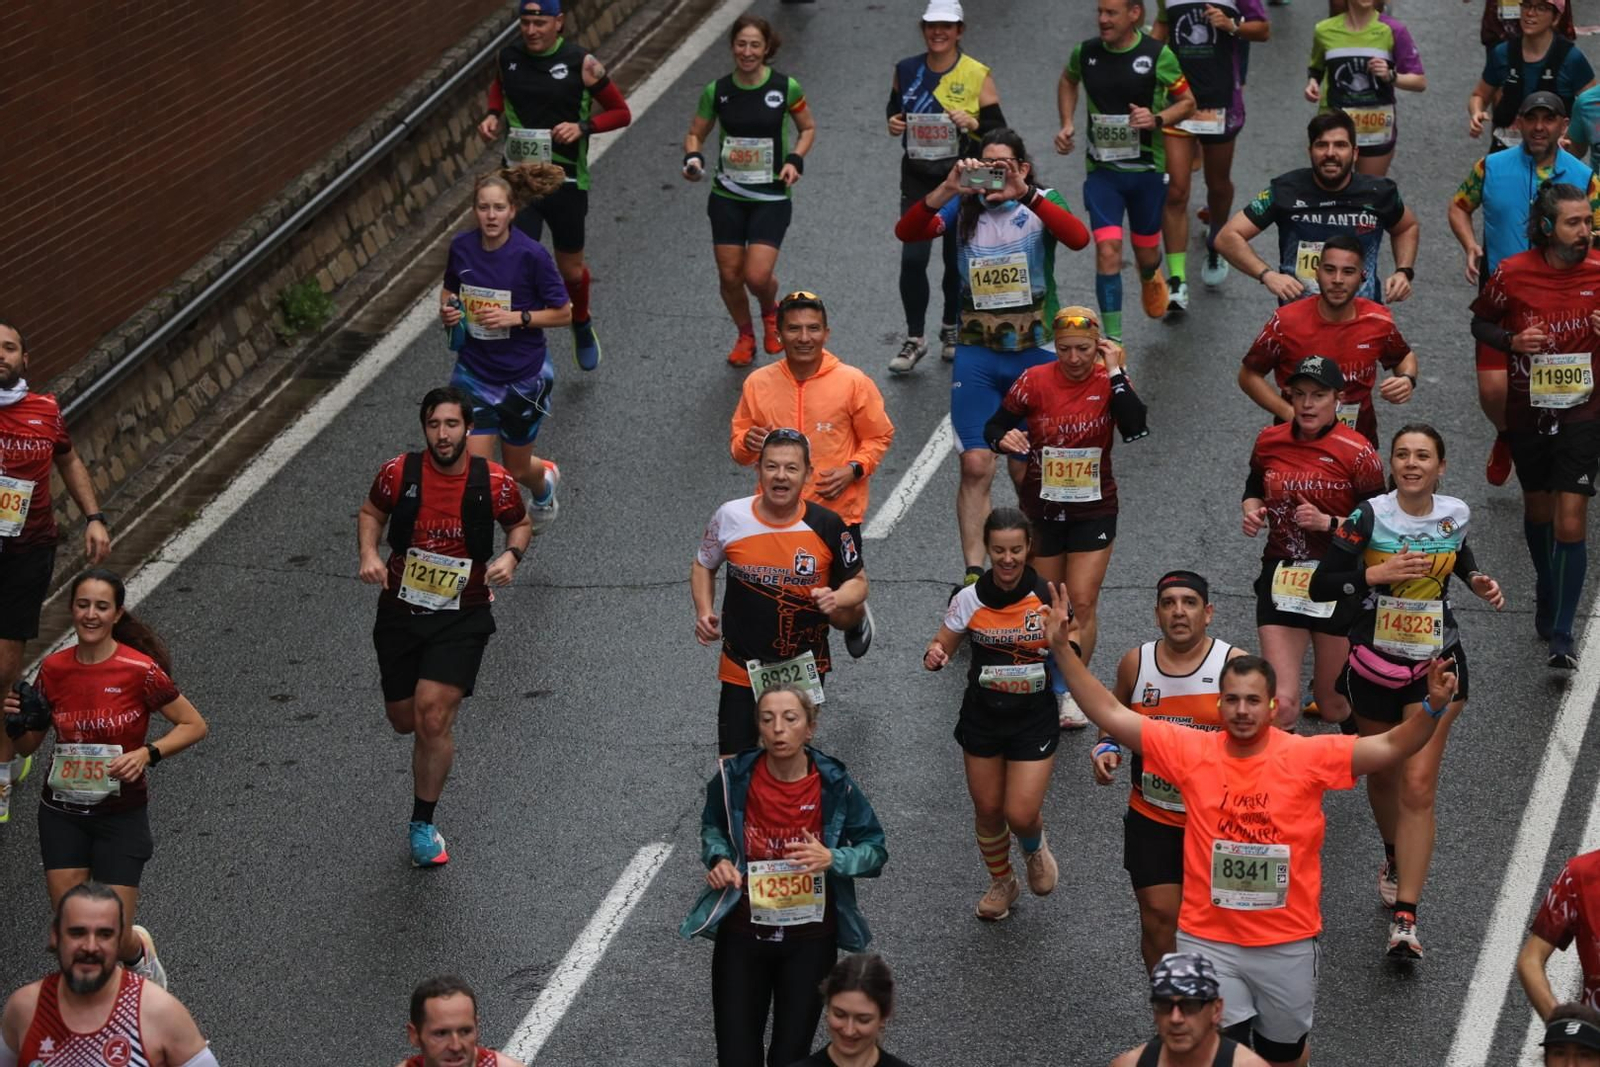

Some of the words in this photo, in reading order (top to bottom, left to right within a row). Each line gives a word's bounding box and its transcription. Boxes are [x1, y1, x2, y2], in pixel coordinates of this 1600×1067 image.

[1350, 113, 1386, 127] 1406
[911, 125, 948, 140] 16233
[1096, 127, 1127, 141] 6858
[1290, 213, 1322, 224] SAN
[1326, 210, 1378, 227] ANTÓN
[974, 267, 1019, 287] 14262
[1549, 317, 1589, 333] MARA
[1535, 368, 1582, 387] 11990
[1047, 461, 1092, 479] 13174
[1, 493, 22, 512] 03
[410, 561, 459, 588] 12177
[762, 574, 779, 585] DE
[1280, 569, 1309, 588] 112
[1383, 612, 1433, 634] 14323
[1001, 634, 1014, 643] DE
[1017, 632, 1044, 643] POBL
[760, 664, 803, 689] 8932
[75, 709, 141, 730] MARATON
[61, 760, 105, 780] 8755
[1152, 774, 1181, 794] 89
[1222, 858, 1269, 881] 8341
[755, 874, 812, 898] 12550
